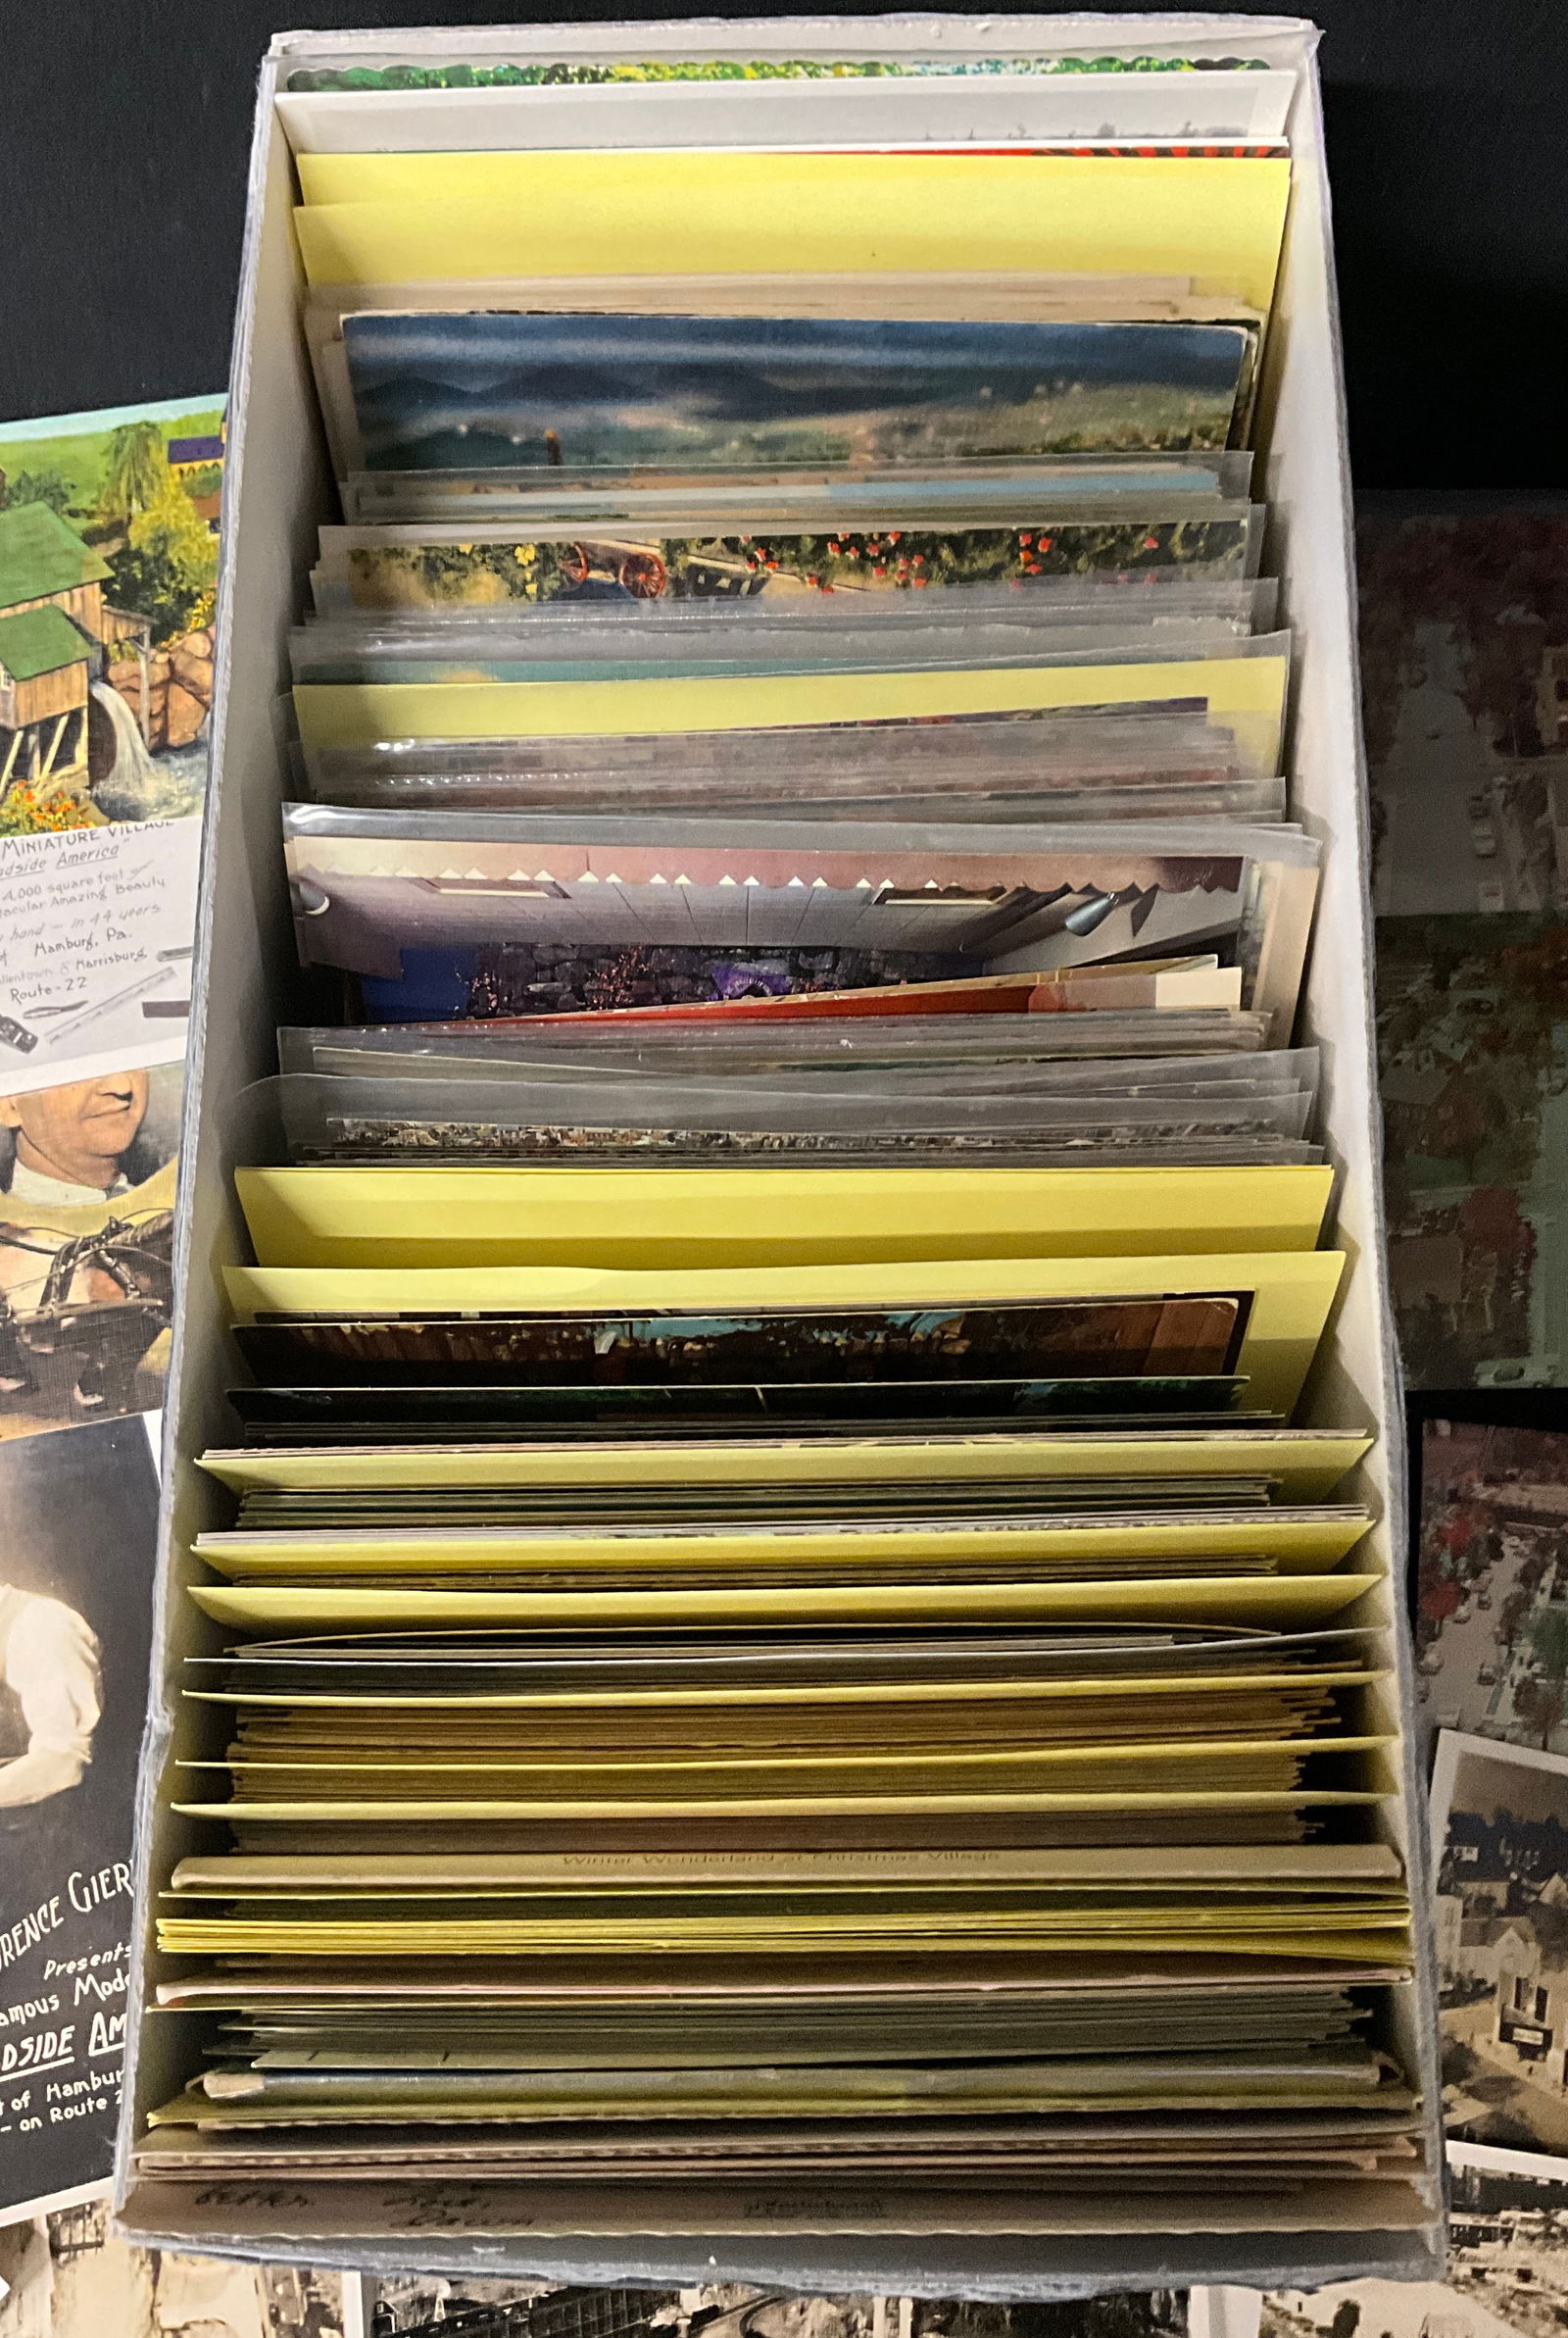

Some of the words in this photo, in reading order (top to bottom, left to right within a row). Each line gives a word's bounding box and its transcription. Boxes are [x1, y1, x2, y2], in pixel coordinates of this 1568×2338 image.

[47, 877, 93, 895] square
[50, 886, 108, 907] Amazing
[116, 875, 166, 894] Beauty
[10, 921, 45, 941] hand
[119, 904, 161, 921] years
[76, 946, 147, 970] Harrisburg
[11, 2089, 31, 2111] of
[20, 2116, 42, 2131] on
[50, 2095, 107, 2124] Route
